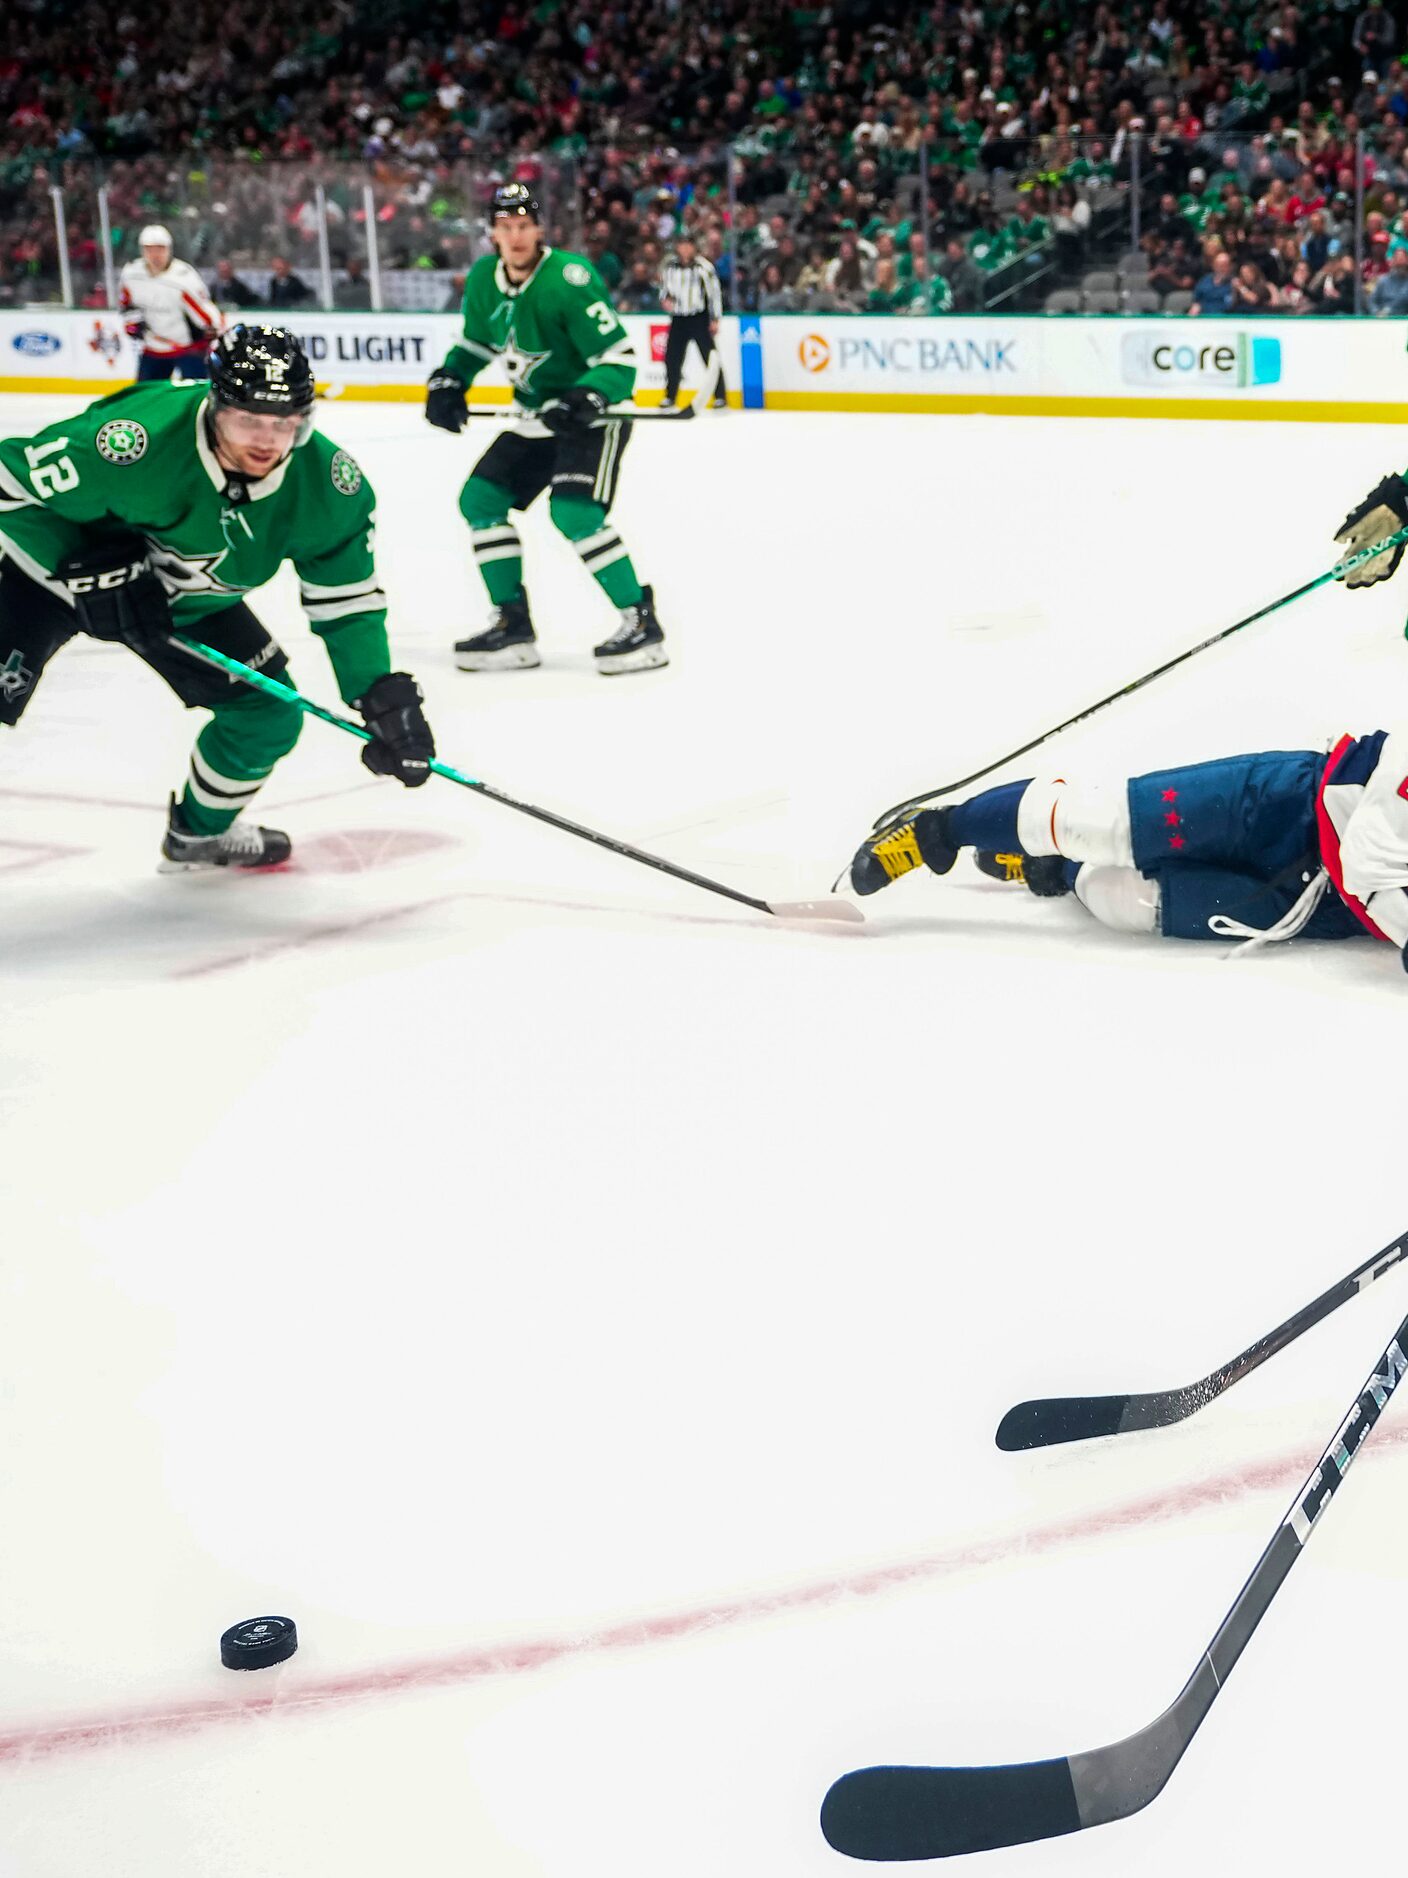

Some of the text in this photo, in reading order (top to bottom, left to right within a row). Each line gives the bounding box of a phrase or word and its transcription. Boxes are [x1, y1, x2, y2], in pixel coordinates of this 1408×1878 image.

[587, 302, 616, 335] 3
[336, 337, 424, 361] LIGHT
[837, 338, 1016, 371] PNC BANK
[1153, 345, 1236, 371] core
[264, 363, 286, 382] 12
[24, 437, 80, 499] 12
